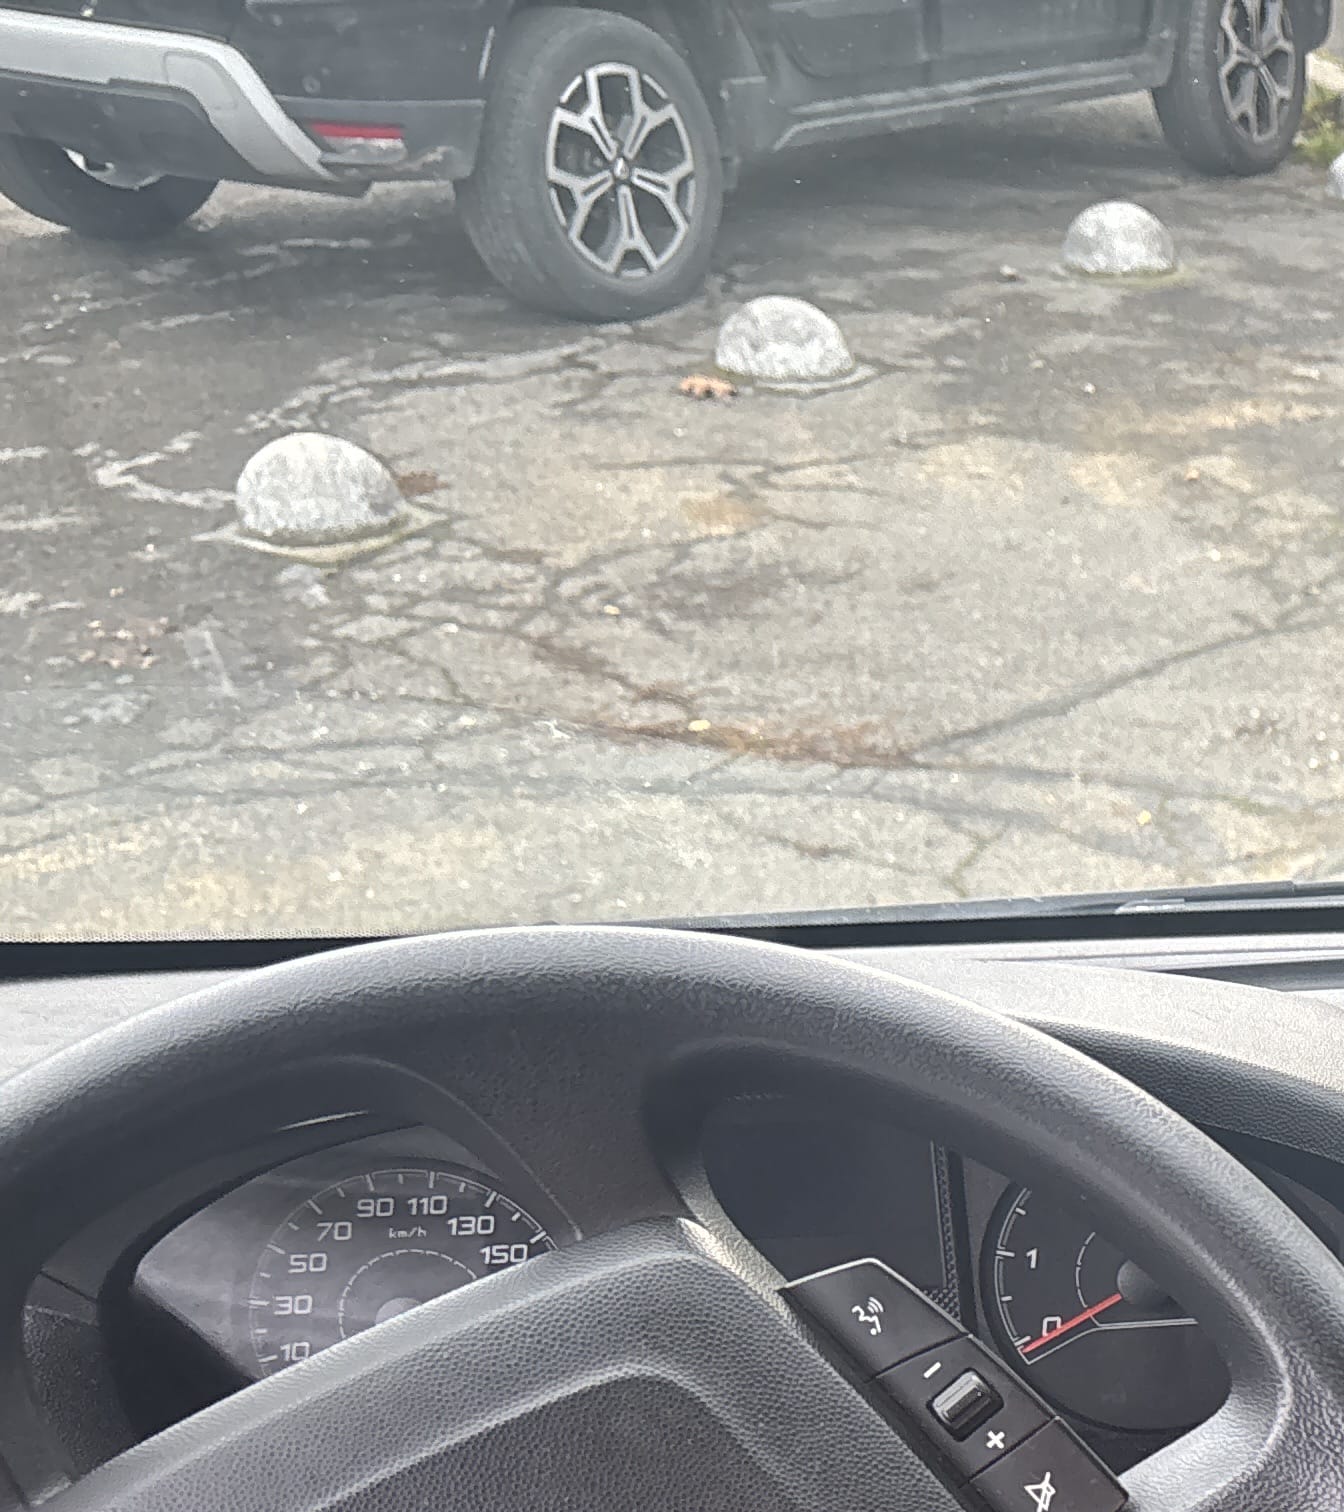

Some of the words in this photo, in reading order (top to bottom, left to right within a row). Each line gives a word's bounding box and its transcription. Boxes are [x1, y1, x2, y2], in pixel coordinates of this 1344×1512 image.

[356, 1197, 395, 1218] 90
[408, 1195, 448, 1216] 110
[316, 1221, 353, 1242] 70
[388, 1225, 427, 1239] km/h
[447, 1215, 495, 1237] 130
[289, 1253, 328, 1273] 50
[481, 1243, 529, 1265] 150
[1025, 1248, 1038, 1269] 1
[272, 1295, 313, 1316] 30
[279, 1341, 310, 1363] 10
